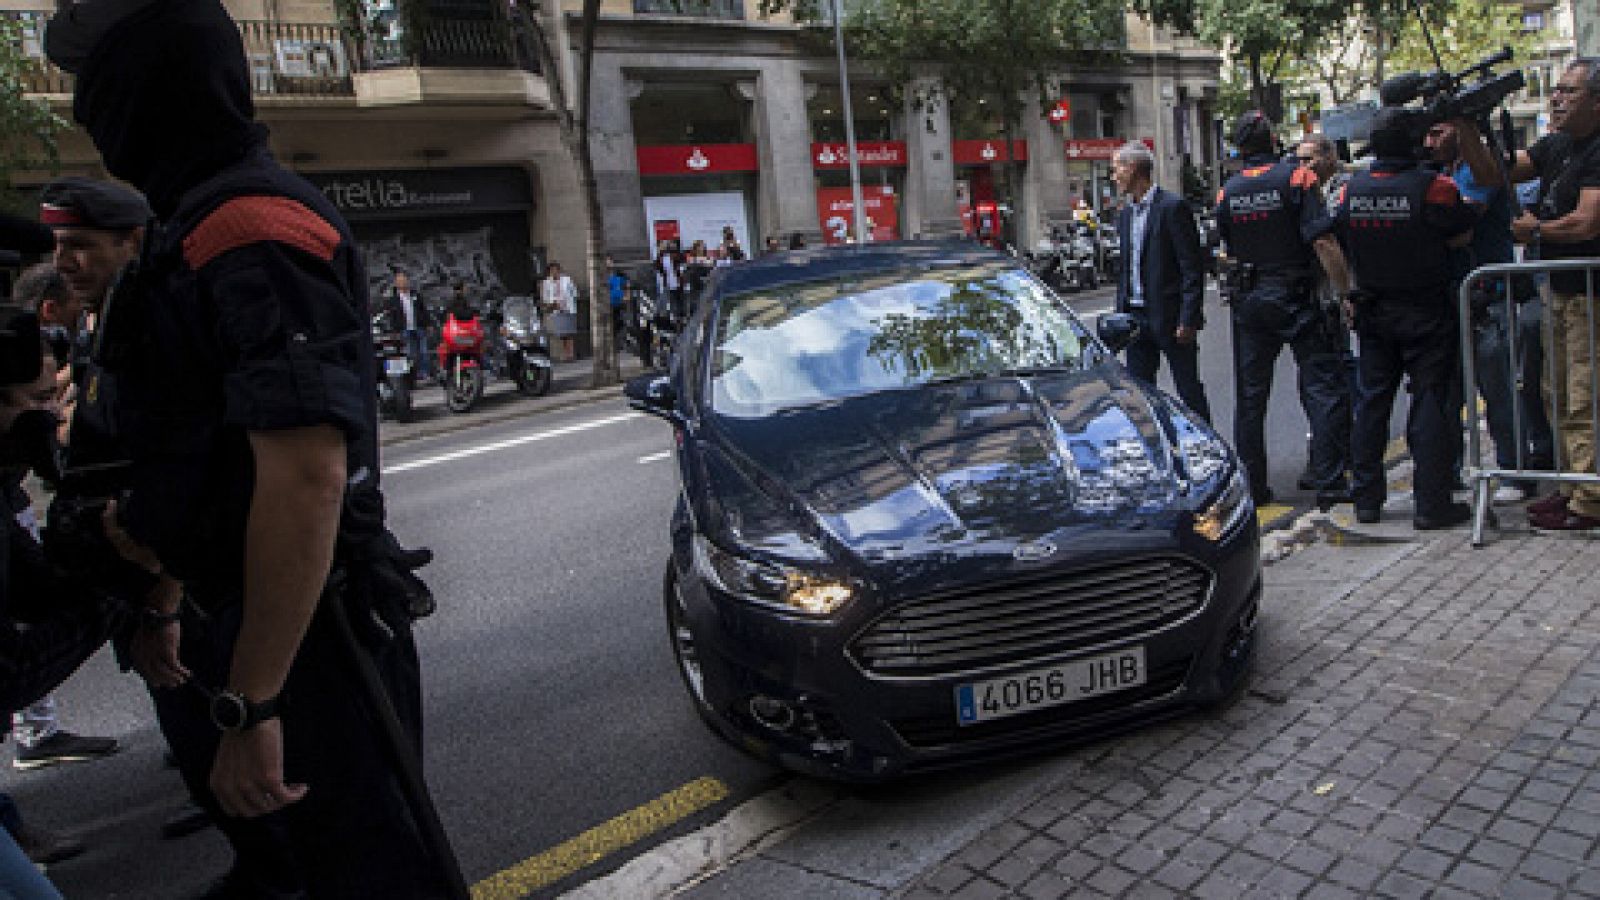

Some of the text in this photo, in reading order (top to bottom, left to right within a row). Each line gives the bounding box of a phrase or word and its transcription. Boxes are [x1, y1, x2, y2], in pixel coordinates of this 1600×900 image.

[836, 145, 898, 163] Satander
[1229, 189, 1281, 210] POLICIA
[1349, 195, 1411, 211] POLICIA
[981, 654, 1138, 713] 4066 JHB
